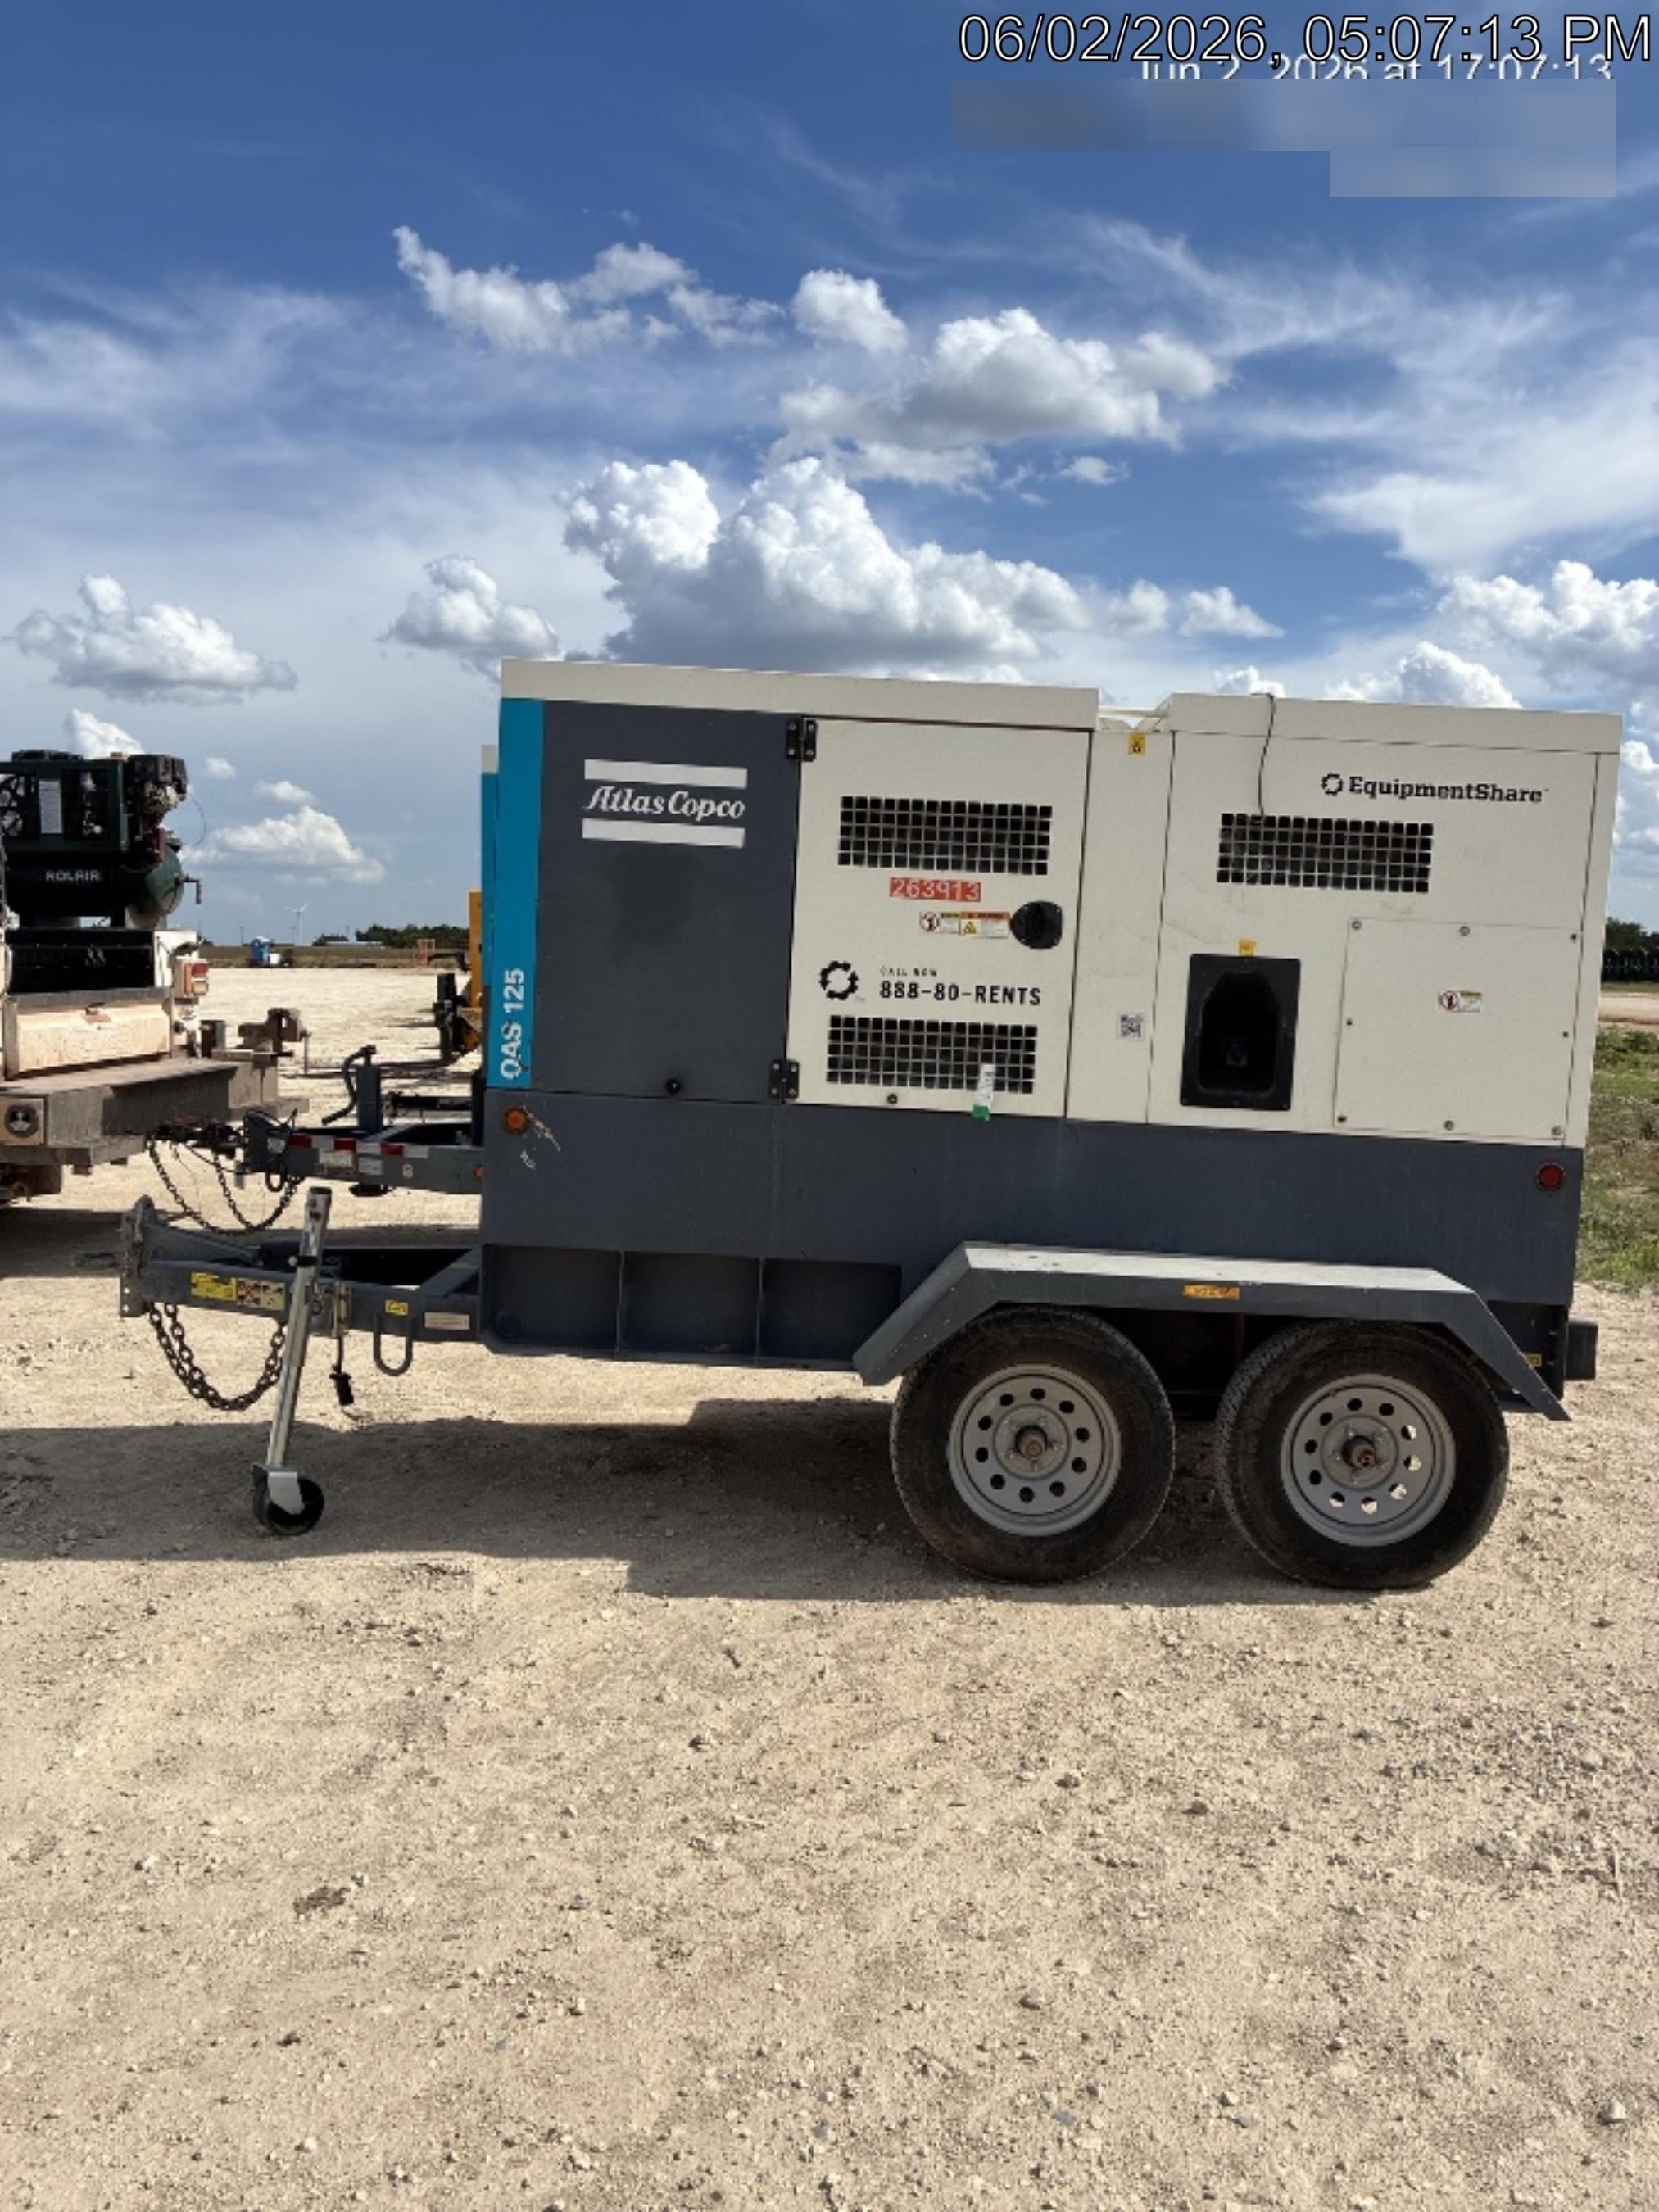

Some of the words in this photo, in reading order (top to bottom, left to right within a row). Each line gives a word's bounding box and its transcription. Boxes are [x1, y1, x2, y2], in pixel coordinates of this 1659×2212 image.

[1349, 776, 1543, 803] EquipmentShare
[891, 877, 981, 901] 263913
[502, 968, 525, 1013] 125
[879, 980, 1041, 1006] 888-80-RENTS
[500, 1022, 523, 1080] QAS
